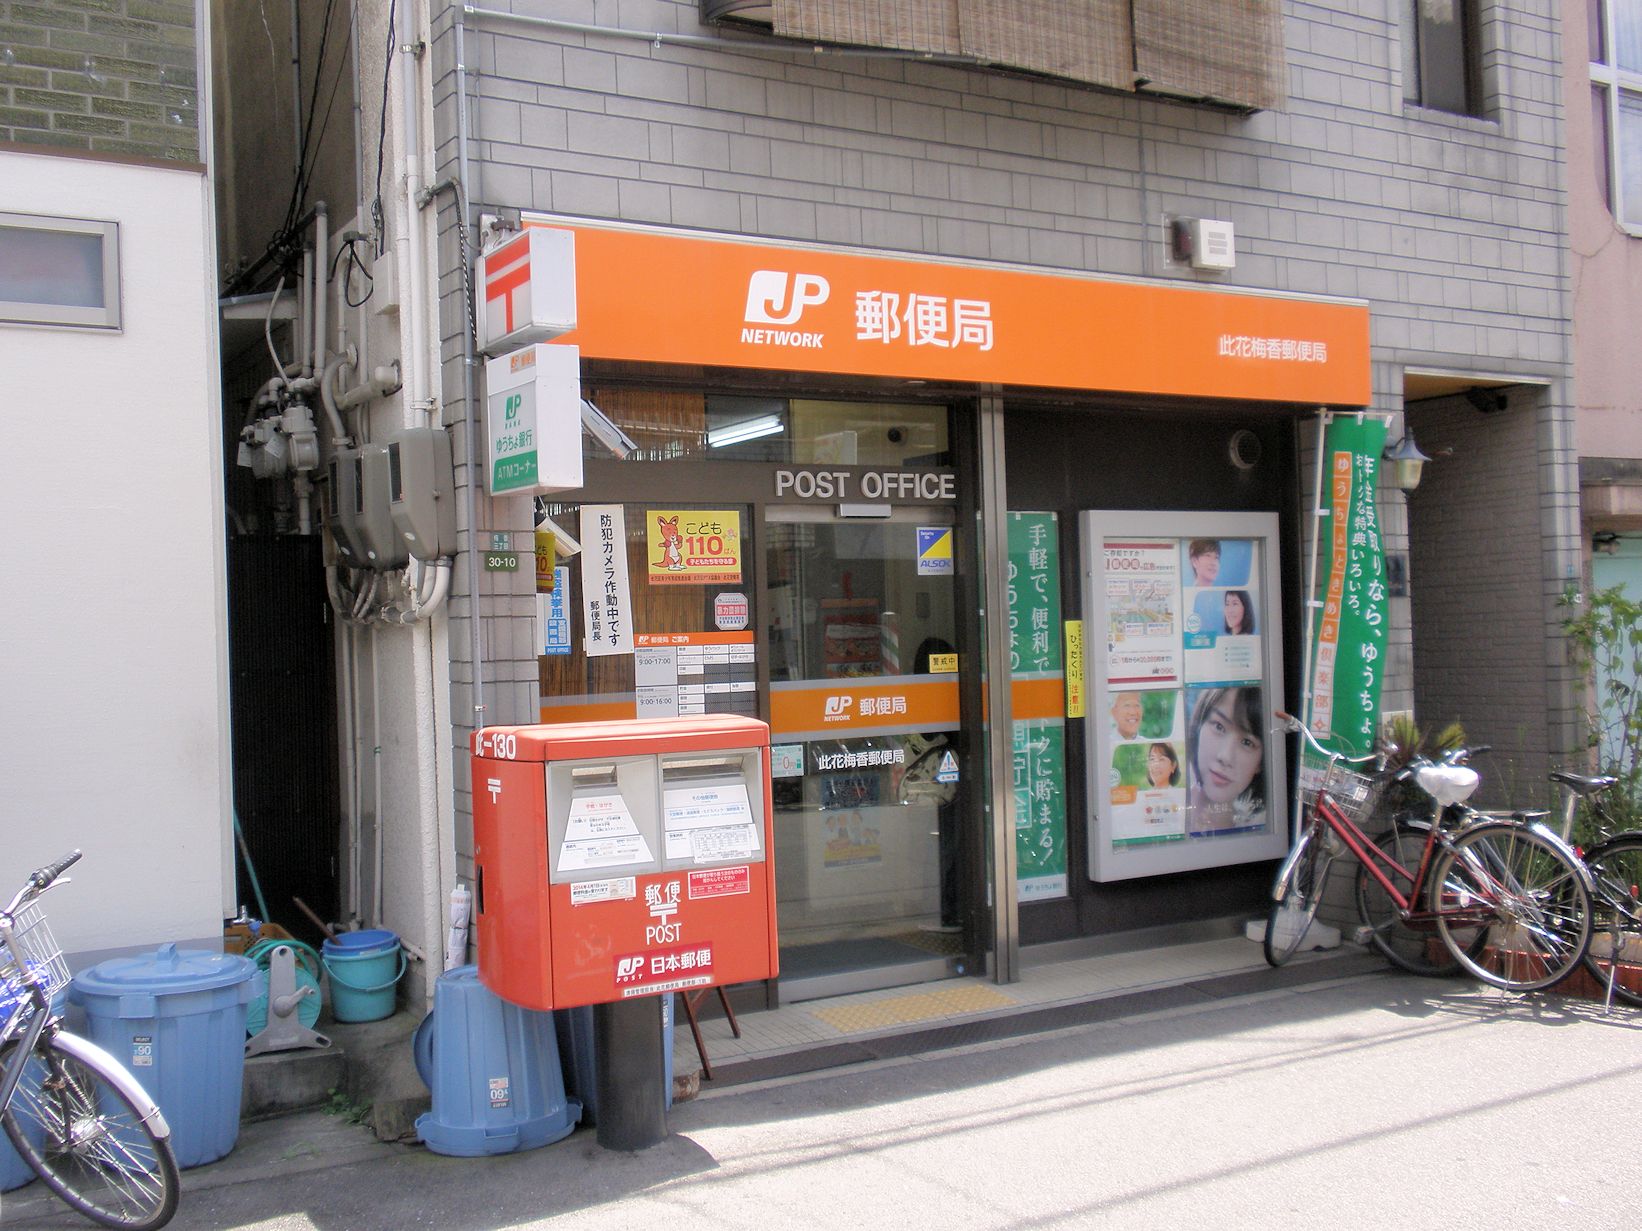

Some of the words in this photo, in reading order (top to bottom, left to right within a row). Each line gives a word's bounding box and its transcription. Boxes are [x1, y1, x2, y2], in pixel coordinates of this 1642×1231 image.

[744, 270, 830, 325] JP
[855, 290, 994, 351] 郵便局
[741, 328, 824, 348] NETWORK
[1218, 334, 1328, 363] 此花梅香郵便局
[505, 393, 522, 420] JP
[495, 429, 533, 454] ゆうちょ銀行
[497, 459, 537, 480] ATMコーナー
[775, 470, 850, 498] POST
[861, 471, 957, 499] OFFICE
[686, 522, 722, 535] こども
[686, 536, 723, 555] 110
[488, 557, 516, 567] 30-10
[600, 514, 620, 646] 防犯カメラ作動中です
[1029, 524, 1050, 676] 手軽で、便利で
[590, 600, 601, 642] 郵便局長
[1071, 635, 1079, 679] ひったくり
[825, 696, 853, 714] JP
[860, 697, 907, 716] 郵便局
[818, 750, 905, 770] 此花梅香郵便局
[645, 880, 681, 906] 郵便
[646, 923, 681, 945] POST
[617, 956, 644, 977] JP
[651, 949, 712, 975] 日本郵便
[616, 974, 643, 983] POST
